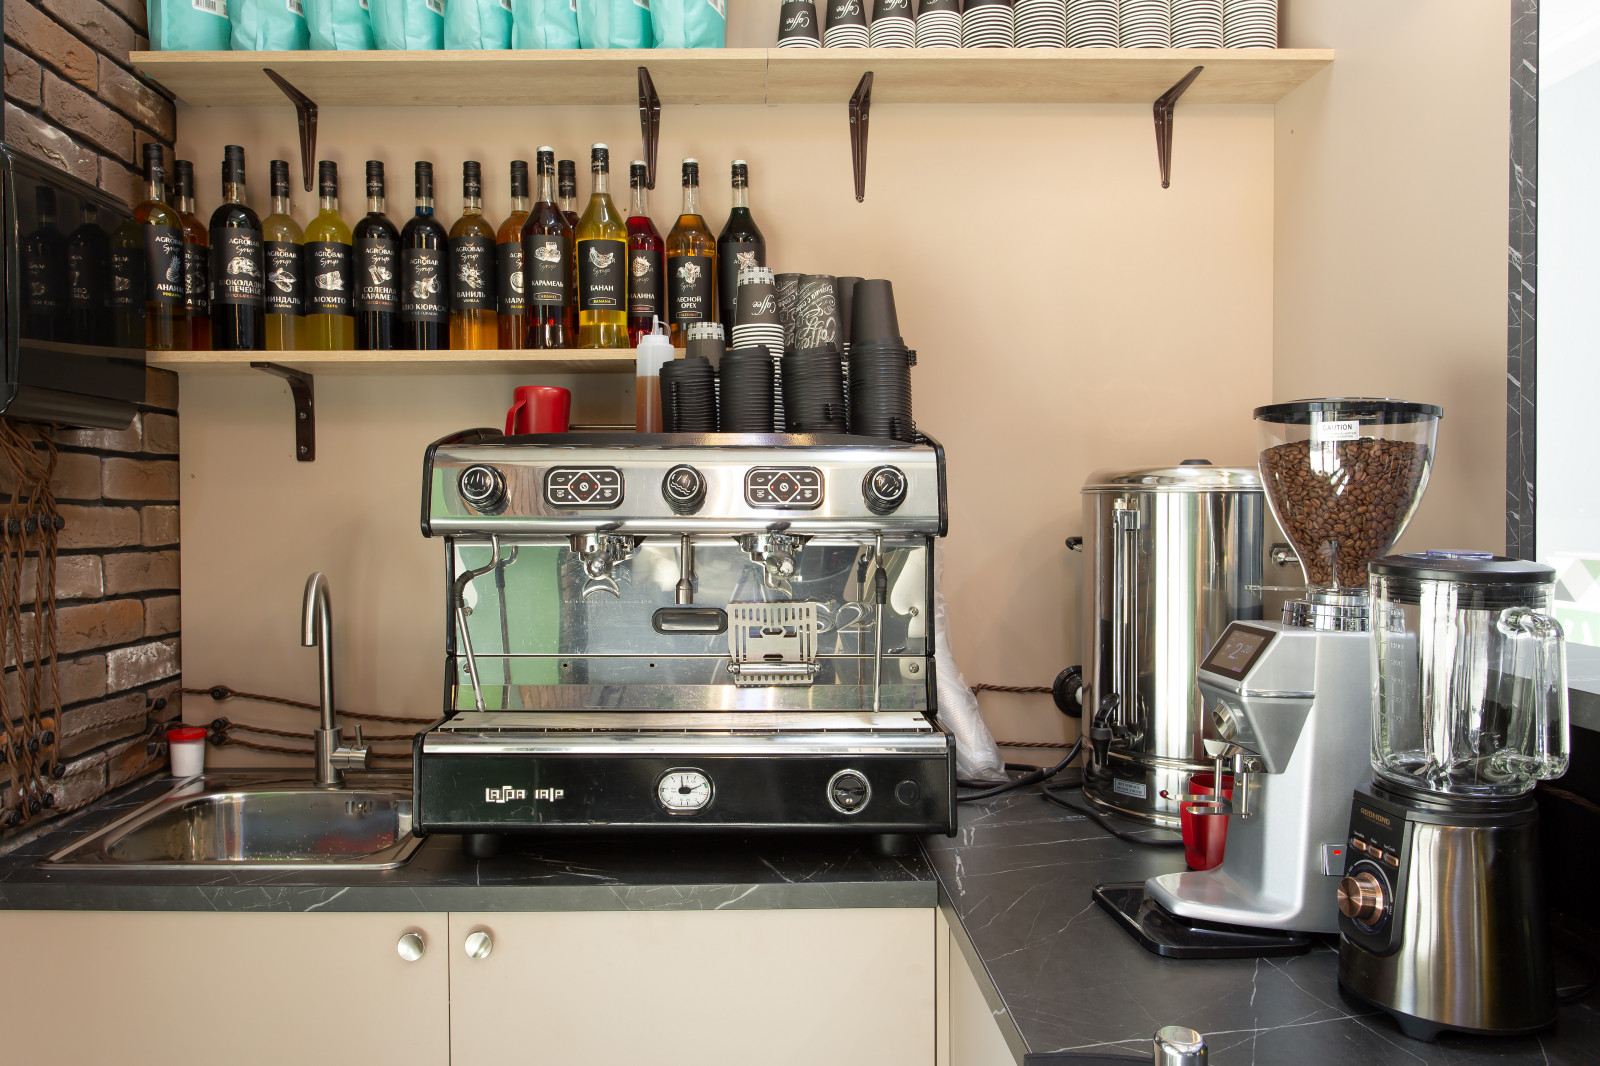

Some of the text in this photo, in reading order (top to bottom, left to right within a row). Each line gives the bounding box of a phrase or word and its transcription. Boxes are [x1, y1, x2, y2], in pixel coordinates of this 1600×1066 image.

[785, 10, 810, 31] Coffee
[531, 279, 564, 288] КАРАМЕЛЬ
[590, 284, 614, 292] БАНАН
[229, 286, 261, 295] ПЕЧЕНЬЕ
[363, 286, 397, 295] СОЛЕНАЯ
[314, 296, 346, 304] МОХИТО
[676, 295, 702, 303] ЛЕСНОЙ
[751, 294, 777, 316] Coffee
[1322, 423, 1353, 431] CAUTION
